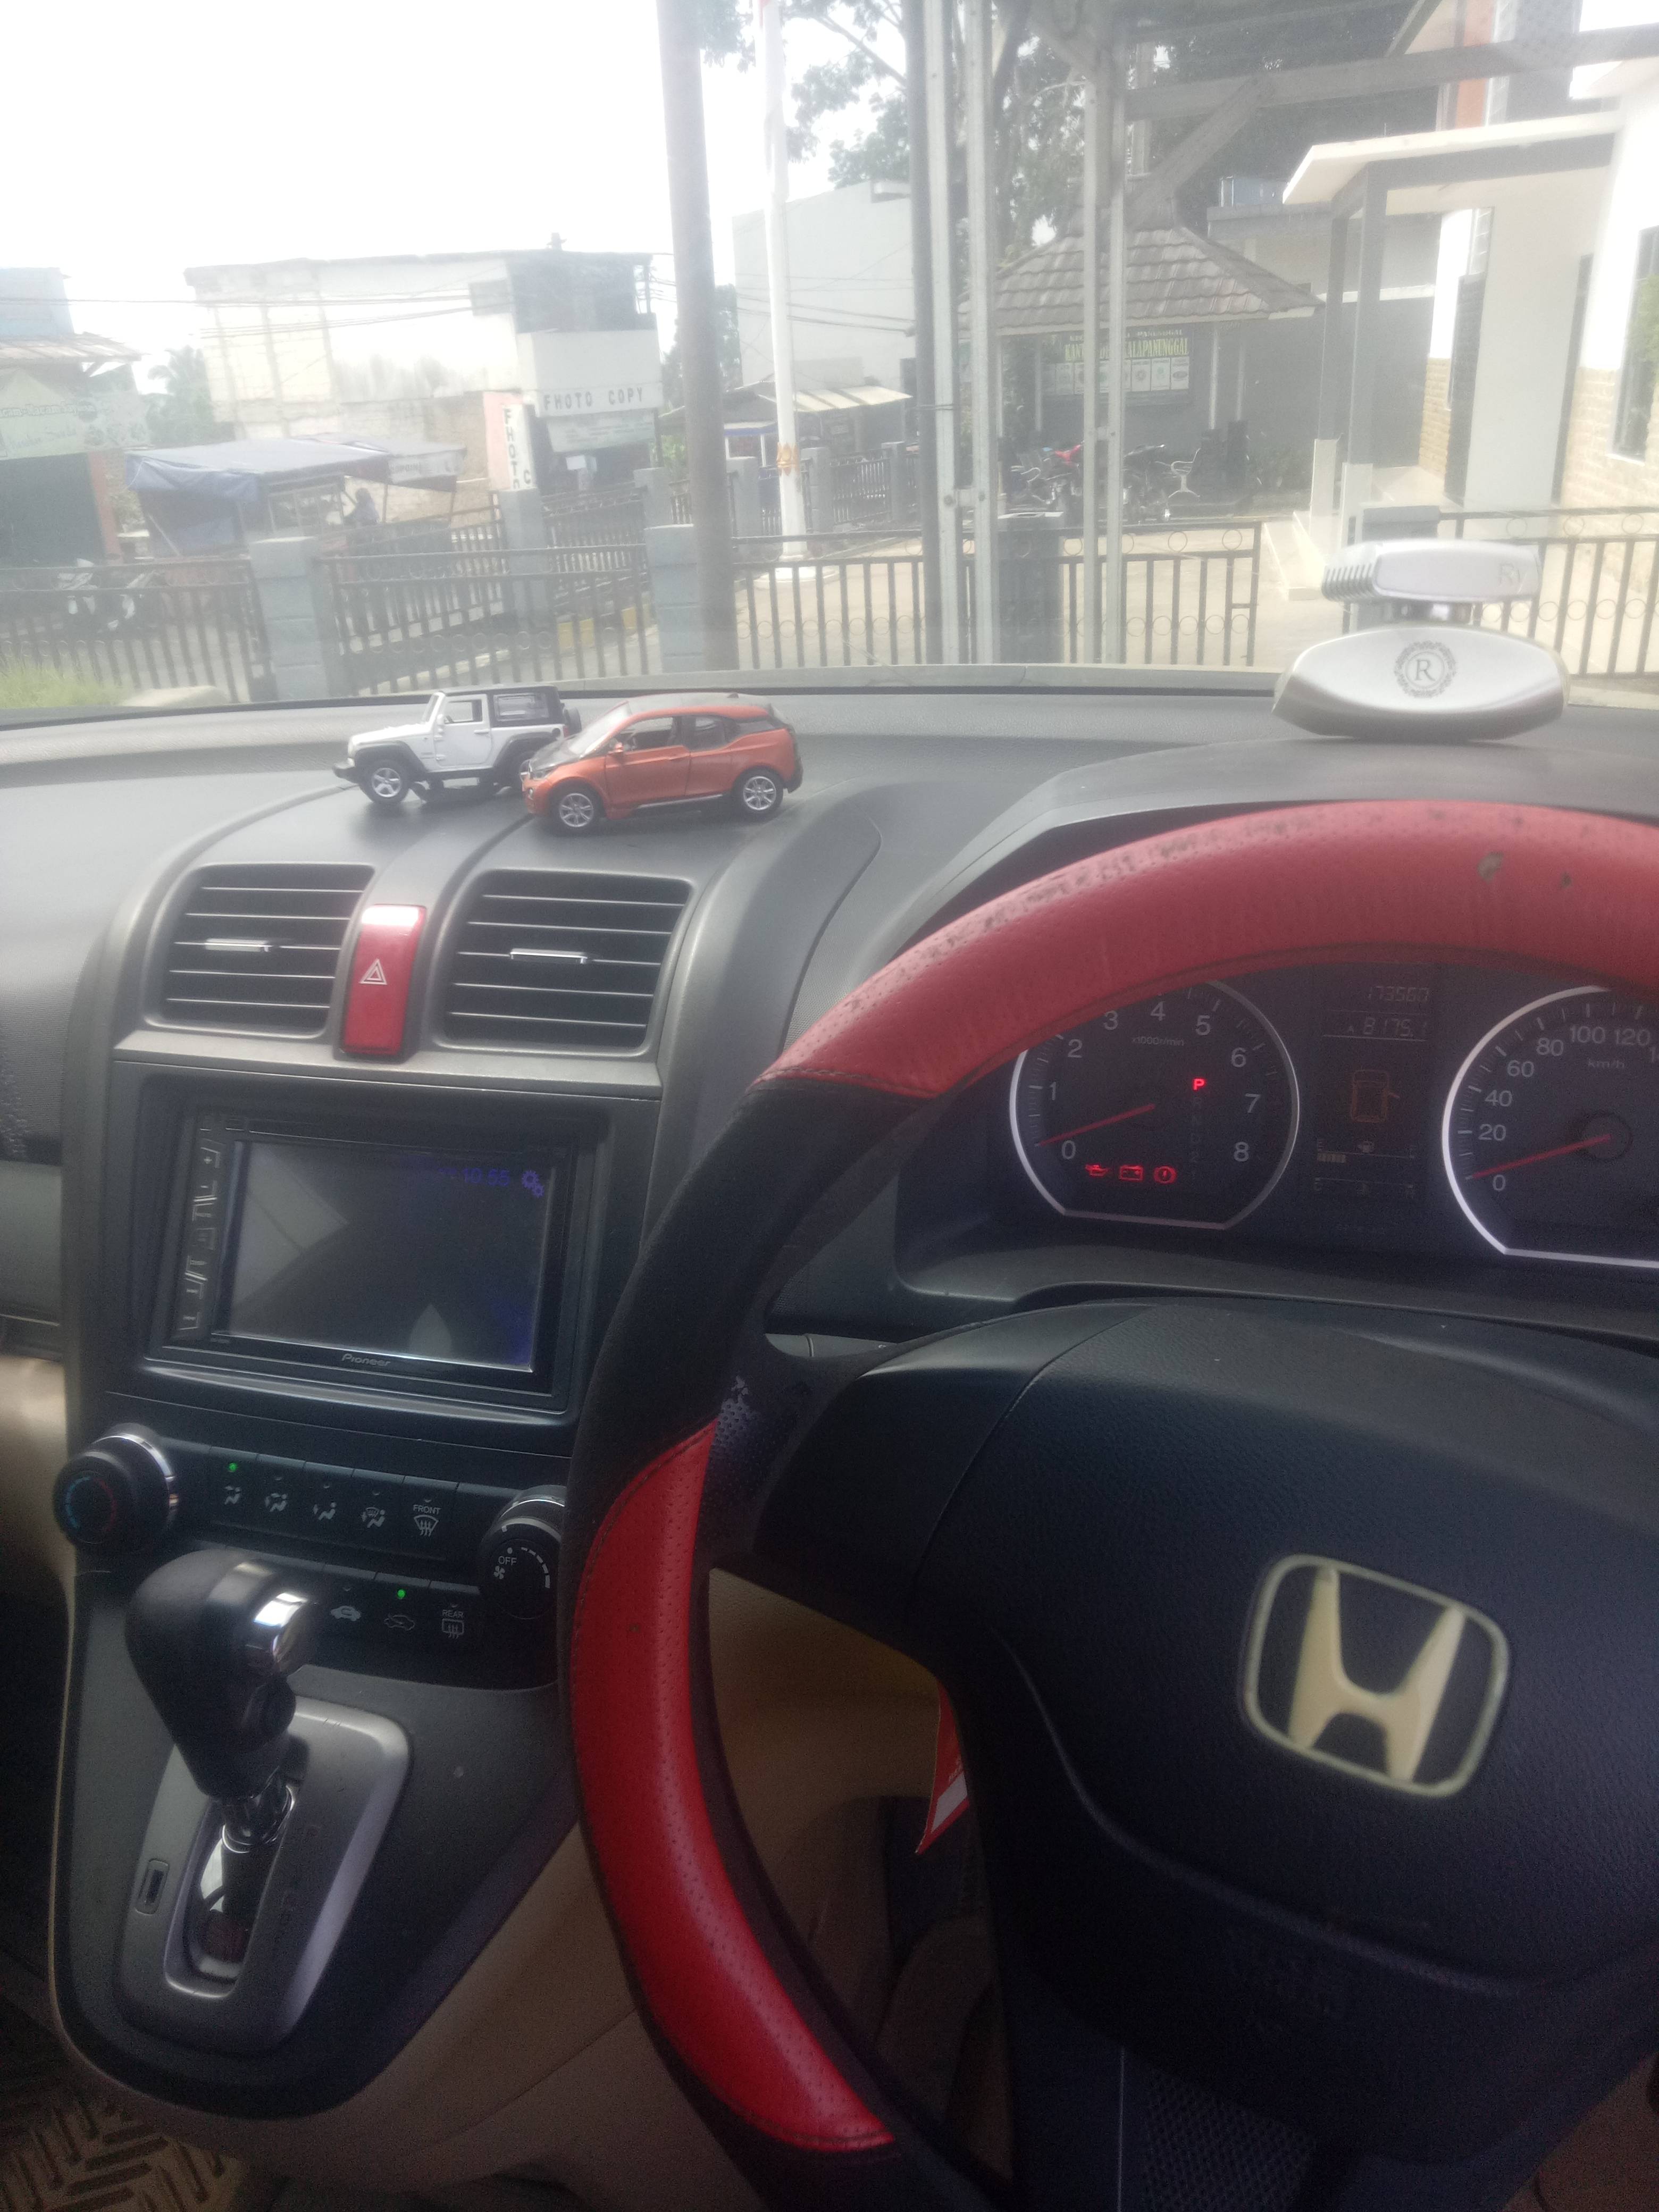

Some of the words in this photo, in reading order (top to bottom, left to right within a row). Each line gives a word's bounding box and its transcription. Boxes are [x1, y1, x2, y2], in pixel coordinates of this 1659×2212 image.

[1126, 338, 1189, 358] ALAPANUNGGAL
[543, 391, 593, 410] FHOTO
[608, 387, 643, 405] COPY
[1414, 659, 1435, 682] R
[1103, 1010, 1118, 1030] 3
[1150, 1001, 1166, 1021] 4
[1196, 1015, 1211, 1036] 5
[1569, 1025, 1606, 1044] 100
[1614, 1028, 1651, 1046] 120
[1067, 1039, 1083, 1058] 2
[1536, 1038, 1564, 1057] 80
[1230, 1048, 1247, 1068] 6
[1506, 1060, 1535, 1077] 60
[1050, 1081, 1057, 1101] 1
[1192, 1077, 1206, 1091] P
[1244, 1093, 1261, 1113] 7
[1485, 1090, 1513, 1108] 40
[1478, 1123, 1507, 1142] 20
[1061, 1141, 1076, 1160] 0
[1233, 1142, 1250, 1162] 8
[1492, 1175, 1506, 1191] 0
[341, 1353, 391, 1367] Pioneer
[413, 1504, 441, 1515] FRONT
[498, 1555, 517, 1566] OFF
[442, 1608, 464, 1619] REAR
